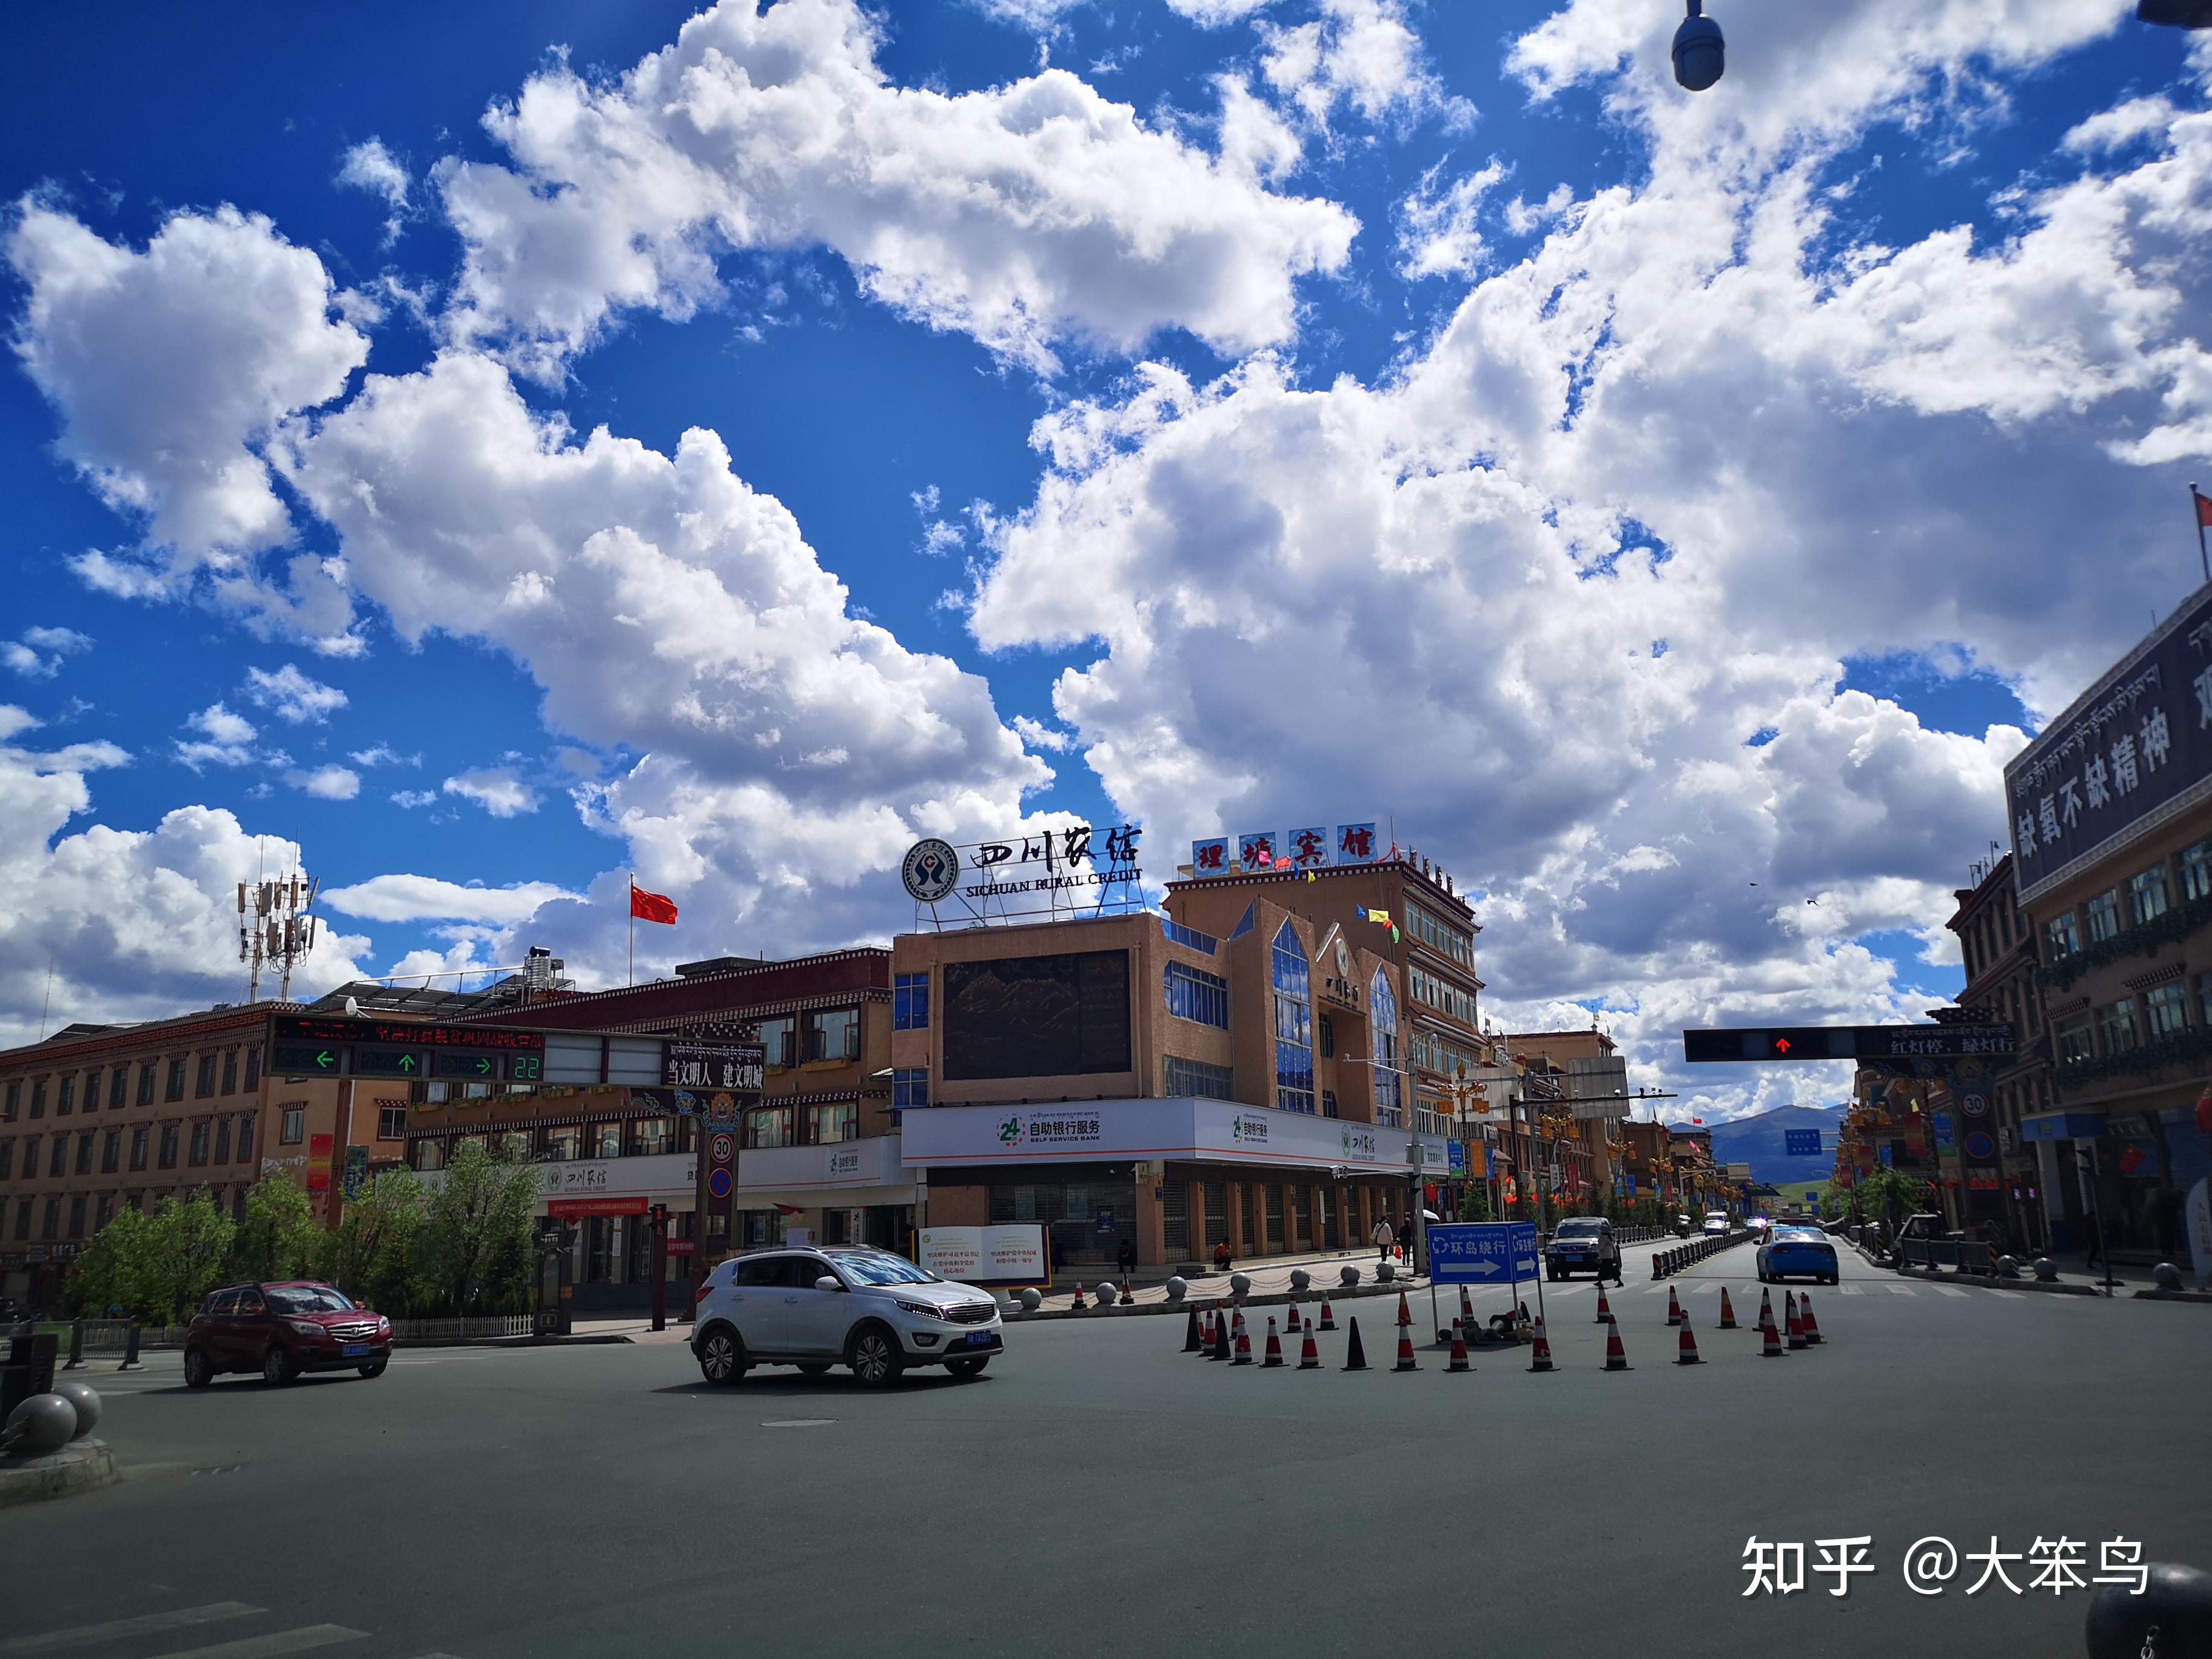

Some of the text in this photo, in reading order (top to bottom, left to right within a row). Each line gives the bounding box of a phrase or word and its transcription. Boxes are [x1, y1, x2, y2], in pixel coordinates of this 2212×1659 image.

[2017, 706, 2171, 858] 缺氧不缺精神
[970, 824, 1142, 872] 四川农信
[966, 868, 1143, 898] SICHUAN RURAL CREDIT
[515, 1057, 539, 1079] 22
[668, 1058, 764, 1090] 当文明人 建文明城
[1966, 1098, 1982, 1111] 30
[1030, 1119, 1100, 1136] 自助银行服务
[1244, 1121, 1268, 1137] 自助银行服务
[716, 1141, 729, 1156] 30
[565, 1170, 607, 1186] 四川农信
[1450, 1240, 1506, 1255] 环岛绕行
[1517, 1238, 1536, 1253] 环岛绕行
